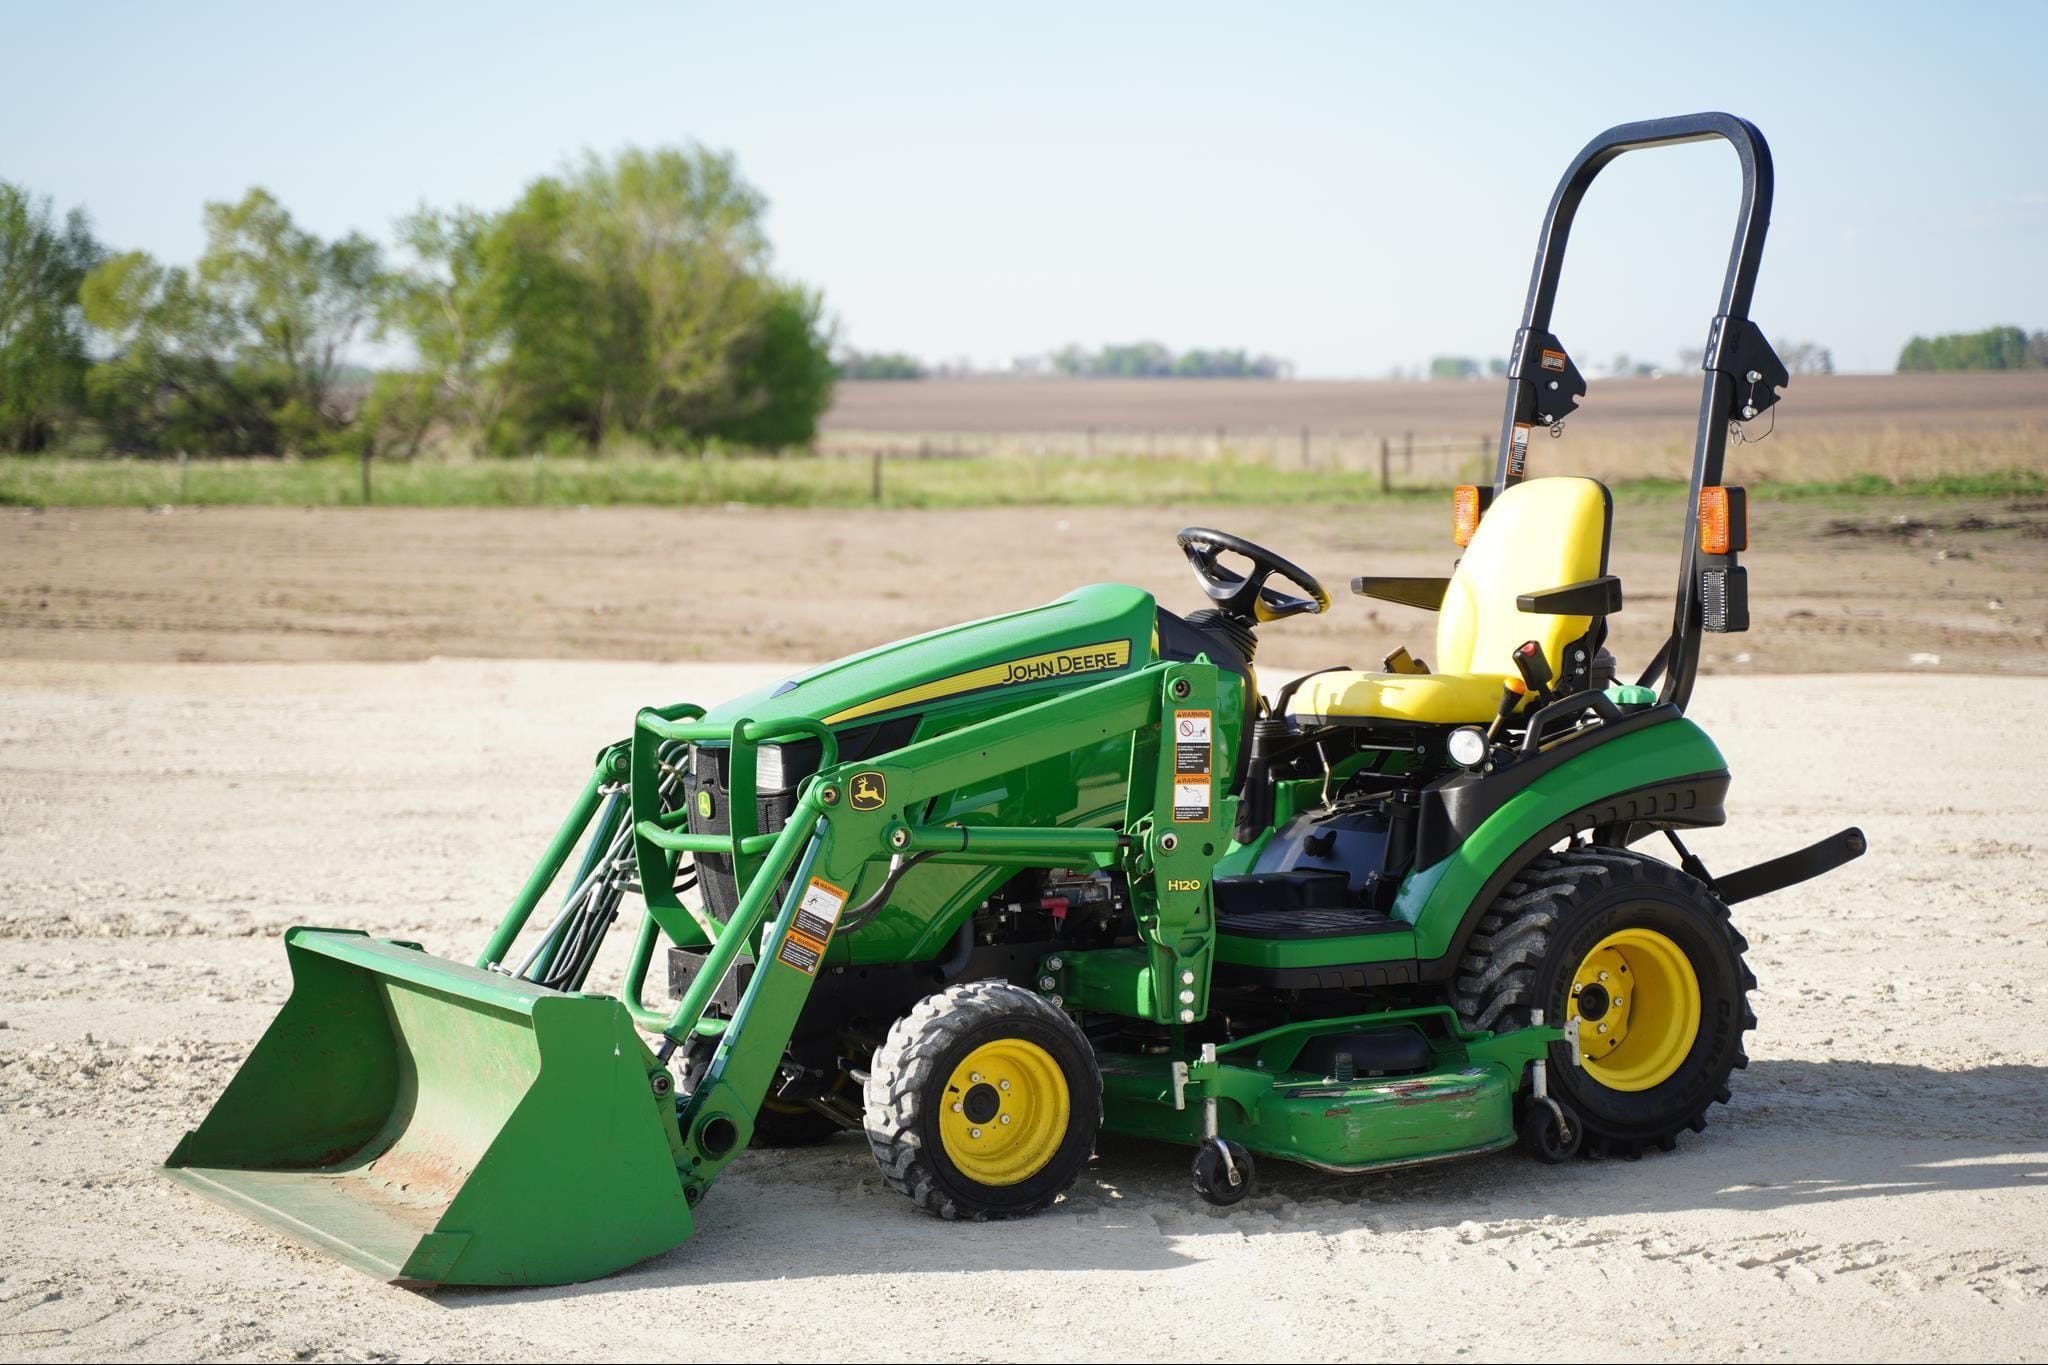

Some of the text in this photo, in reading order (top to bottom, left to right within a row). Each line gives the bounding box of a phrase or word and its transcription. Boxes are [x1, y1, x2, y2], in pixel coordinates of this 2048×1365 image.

[1003, 652, 1117, 682] JOHN DEERE
[1168, 880, 1200, 891] H120
